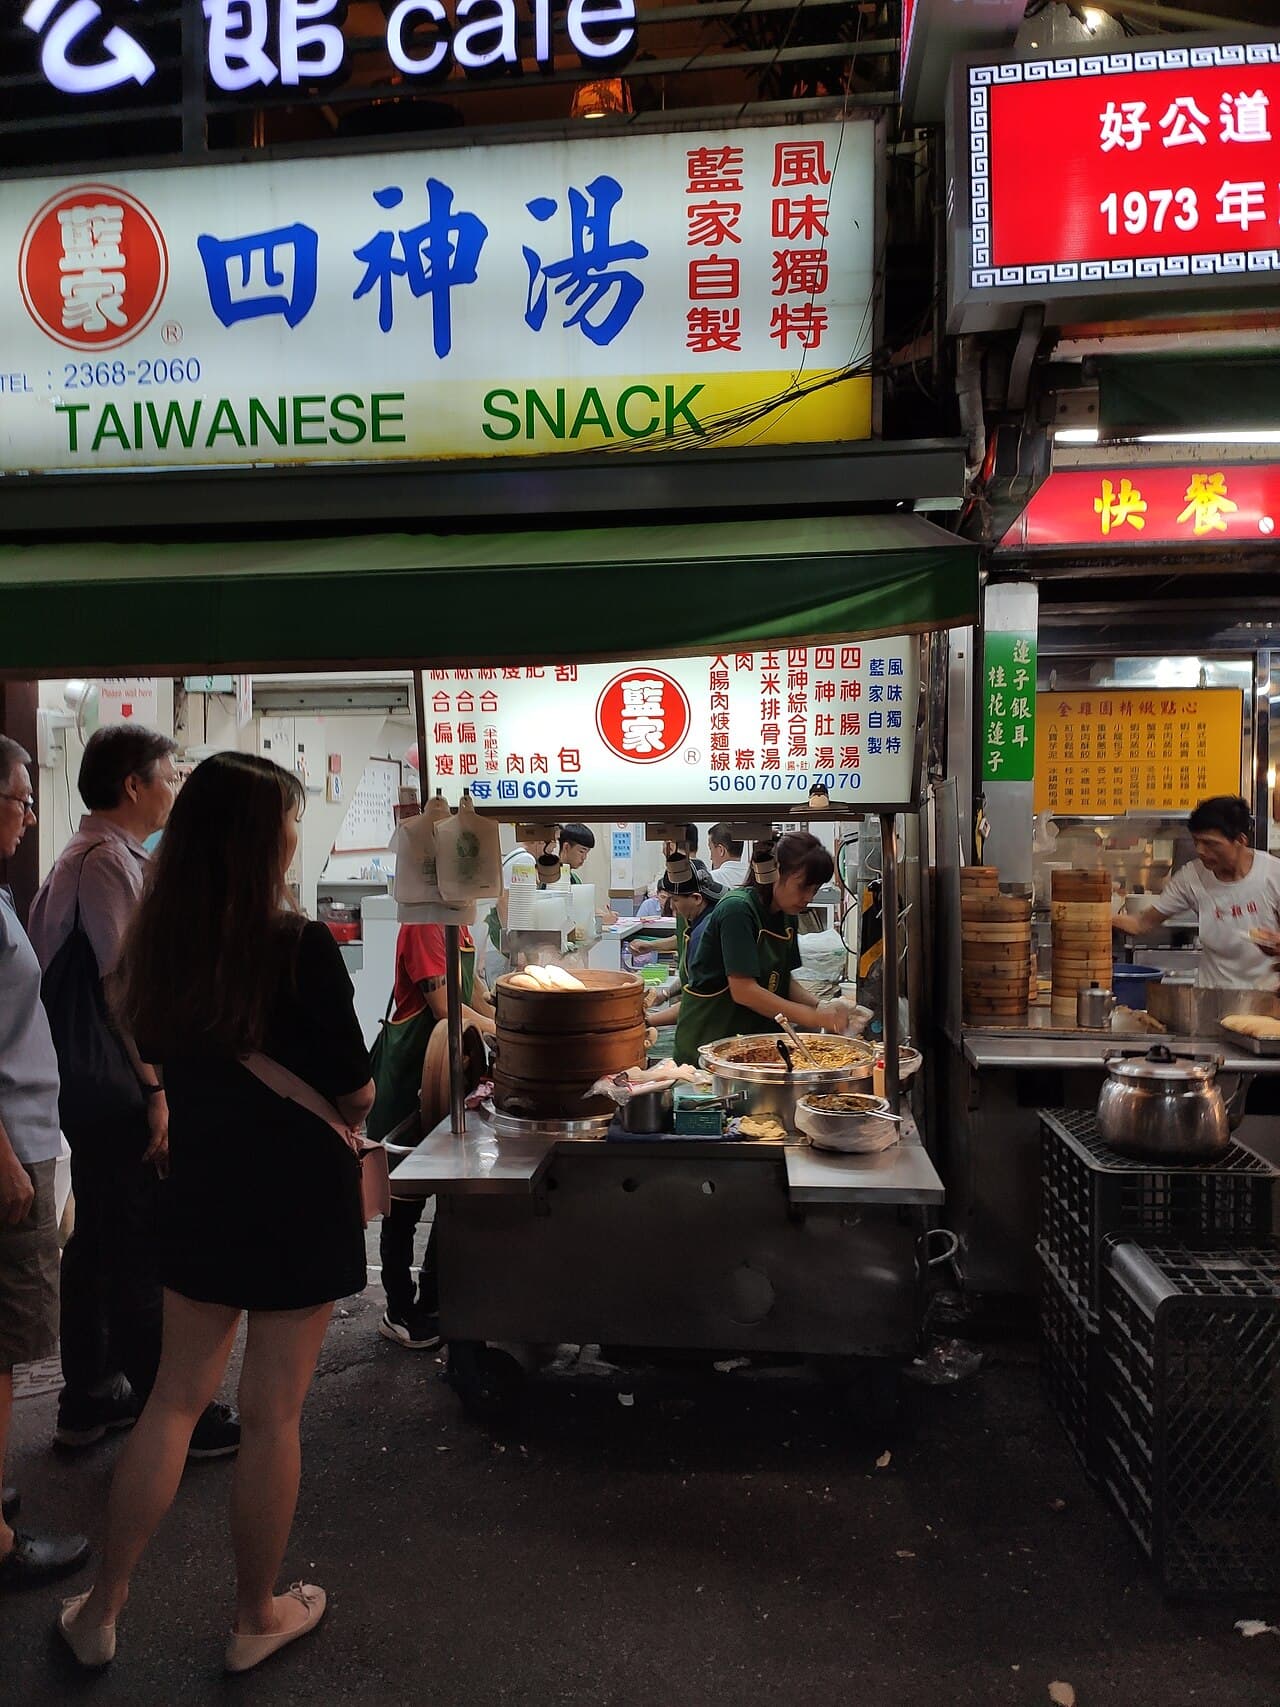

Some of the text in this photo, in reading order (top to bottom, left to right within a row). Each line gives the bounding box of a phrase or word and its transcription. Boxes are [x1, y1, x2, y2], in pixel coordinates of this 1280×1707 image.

[1099, 89, 1272, 152] 好公道
[198, 175, 648, 358] 四神湯
[685, 146, 744, 353] 藍家自製
[770, 140, 832, 350] 風味獨特
[55, 384, 710, 452] TAIWANESE SNACK
[63, 357, 201, 390] 2368-2060
[1094, 472, 1239, 536] 快餐
[620, 679, 666, 753] 藍家
[759, 650, 781, 771] 玉米排骨湯
[786, 648, 808, 758] 四神綜合湯
[814, 647, 836, 769] 四神肚湯
[840, 646, 861, 769] 四神腸湯
[867, 658, 885, 755] 藍家自製
[886, 657, 904, 755] 風味獨特
[988, 665, 1007, 772] 桂花蓮子
[1010, 639, 1032, 748] 蓮子銀耳
[470, 779, 579, 800] 每個60元
[709, 775, 731, 791] 50
[734, 775, 756, 791] 60
[760, 774, 782, 790] 70
[785, 774, 808, 790] 70
[838, 773, 861, 789] 70
